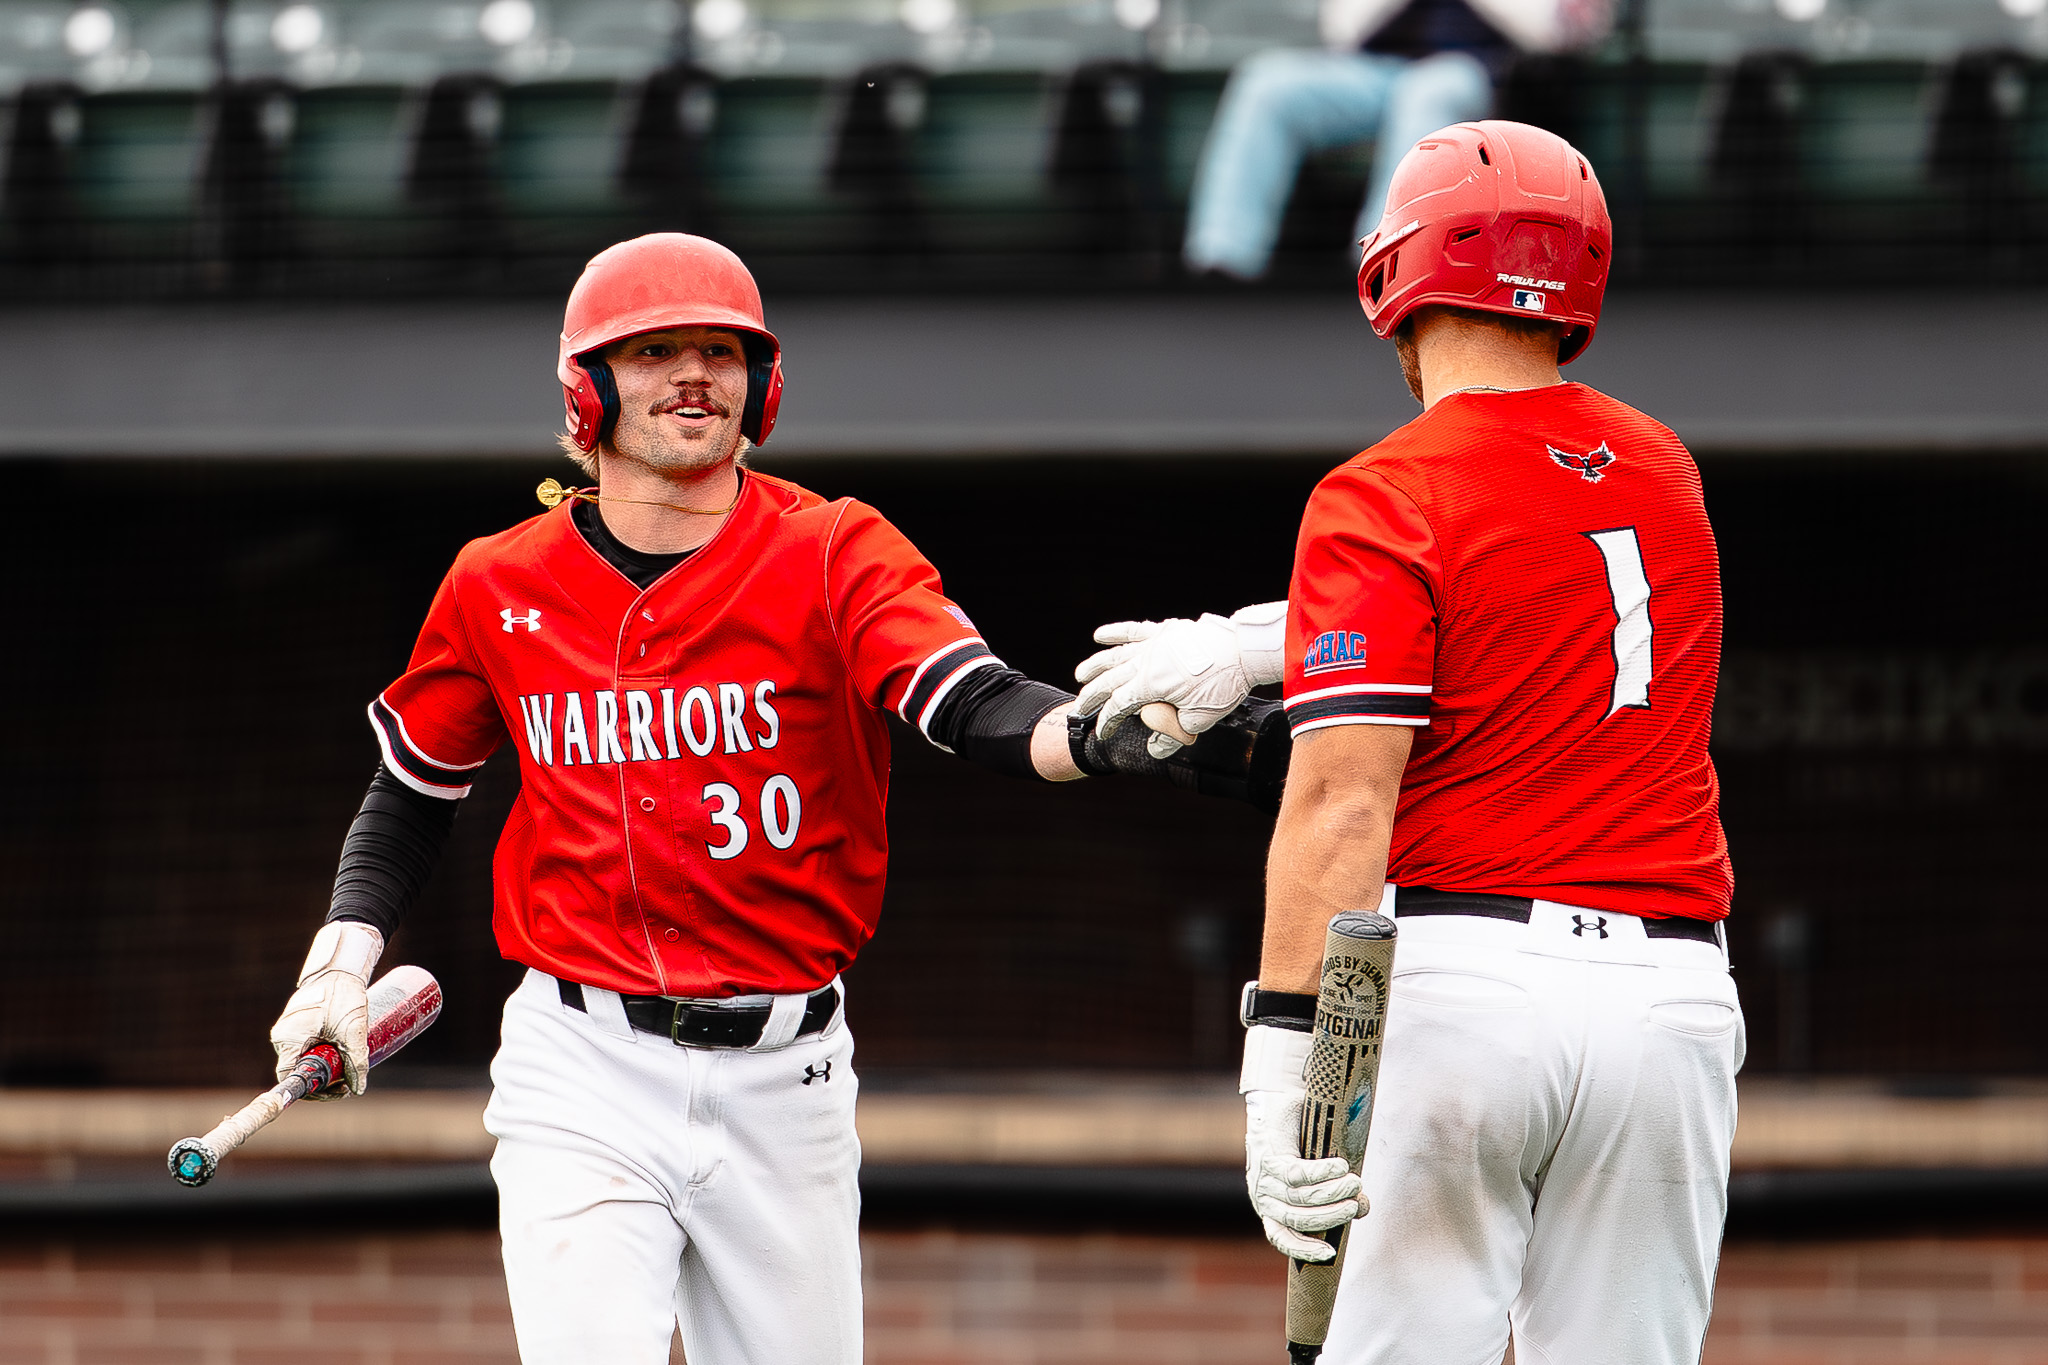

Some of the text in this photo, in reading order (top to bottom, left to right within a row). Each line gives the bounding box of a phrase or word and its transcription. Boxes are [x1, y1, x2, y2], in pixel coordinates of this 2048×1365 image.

[1496, 272, 1567, 292] RAWLINGS
[1577, 525, 1655, 733] 1
[1304, 630, 1367, 669] WHAC
[518, 679, 781, 767] WARRIORS
[700, 773, 801, 860] 30
[1321, 955, 1342, 983] OODS
[1344, 955, 1361, 971] BY
[1317, 1009, 1381, 1040] RIGINAL
